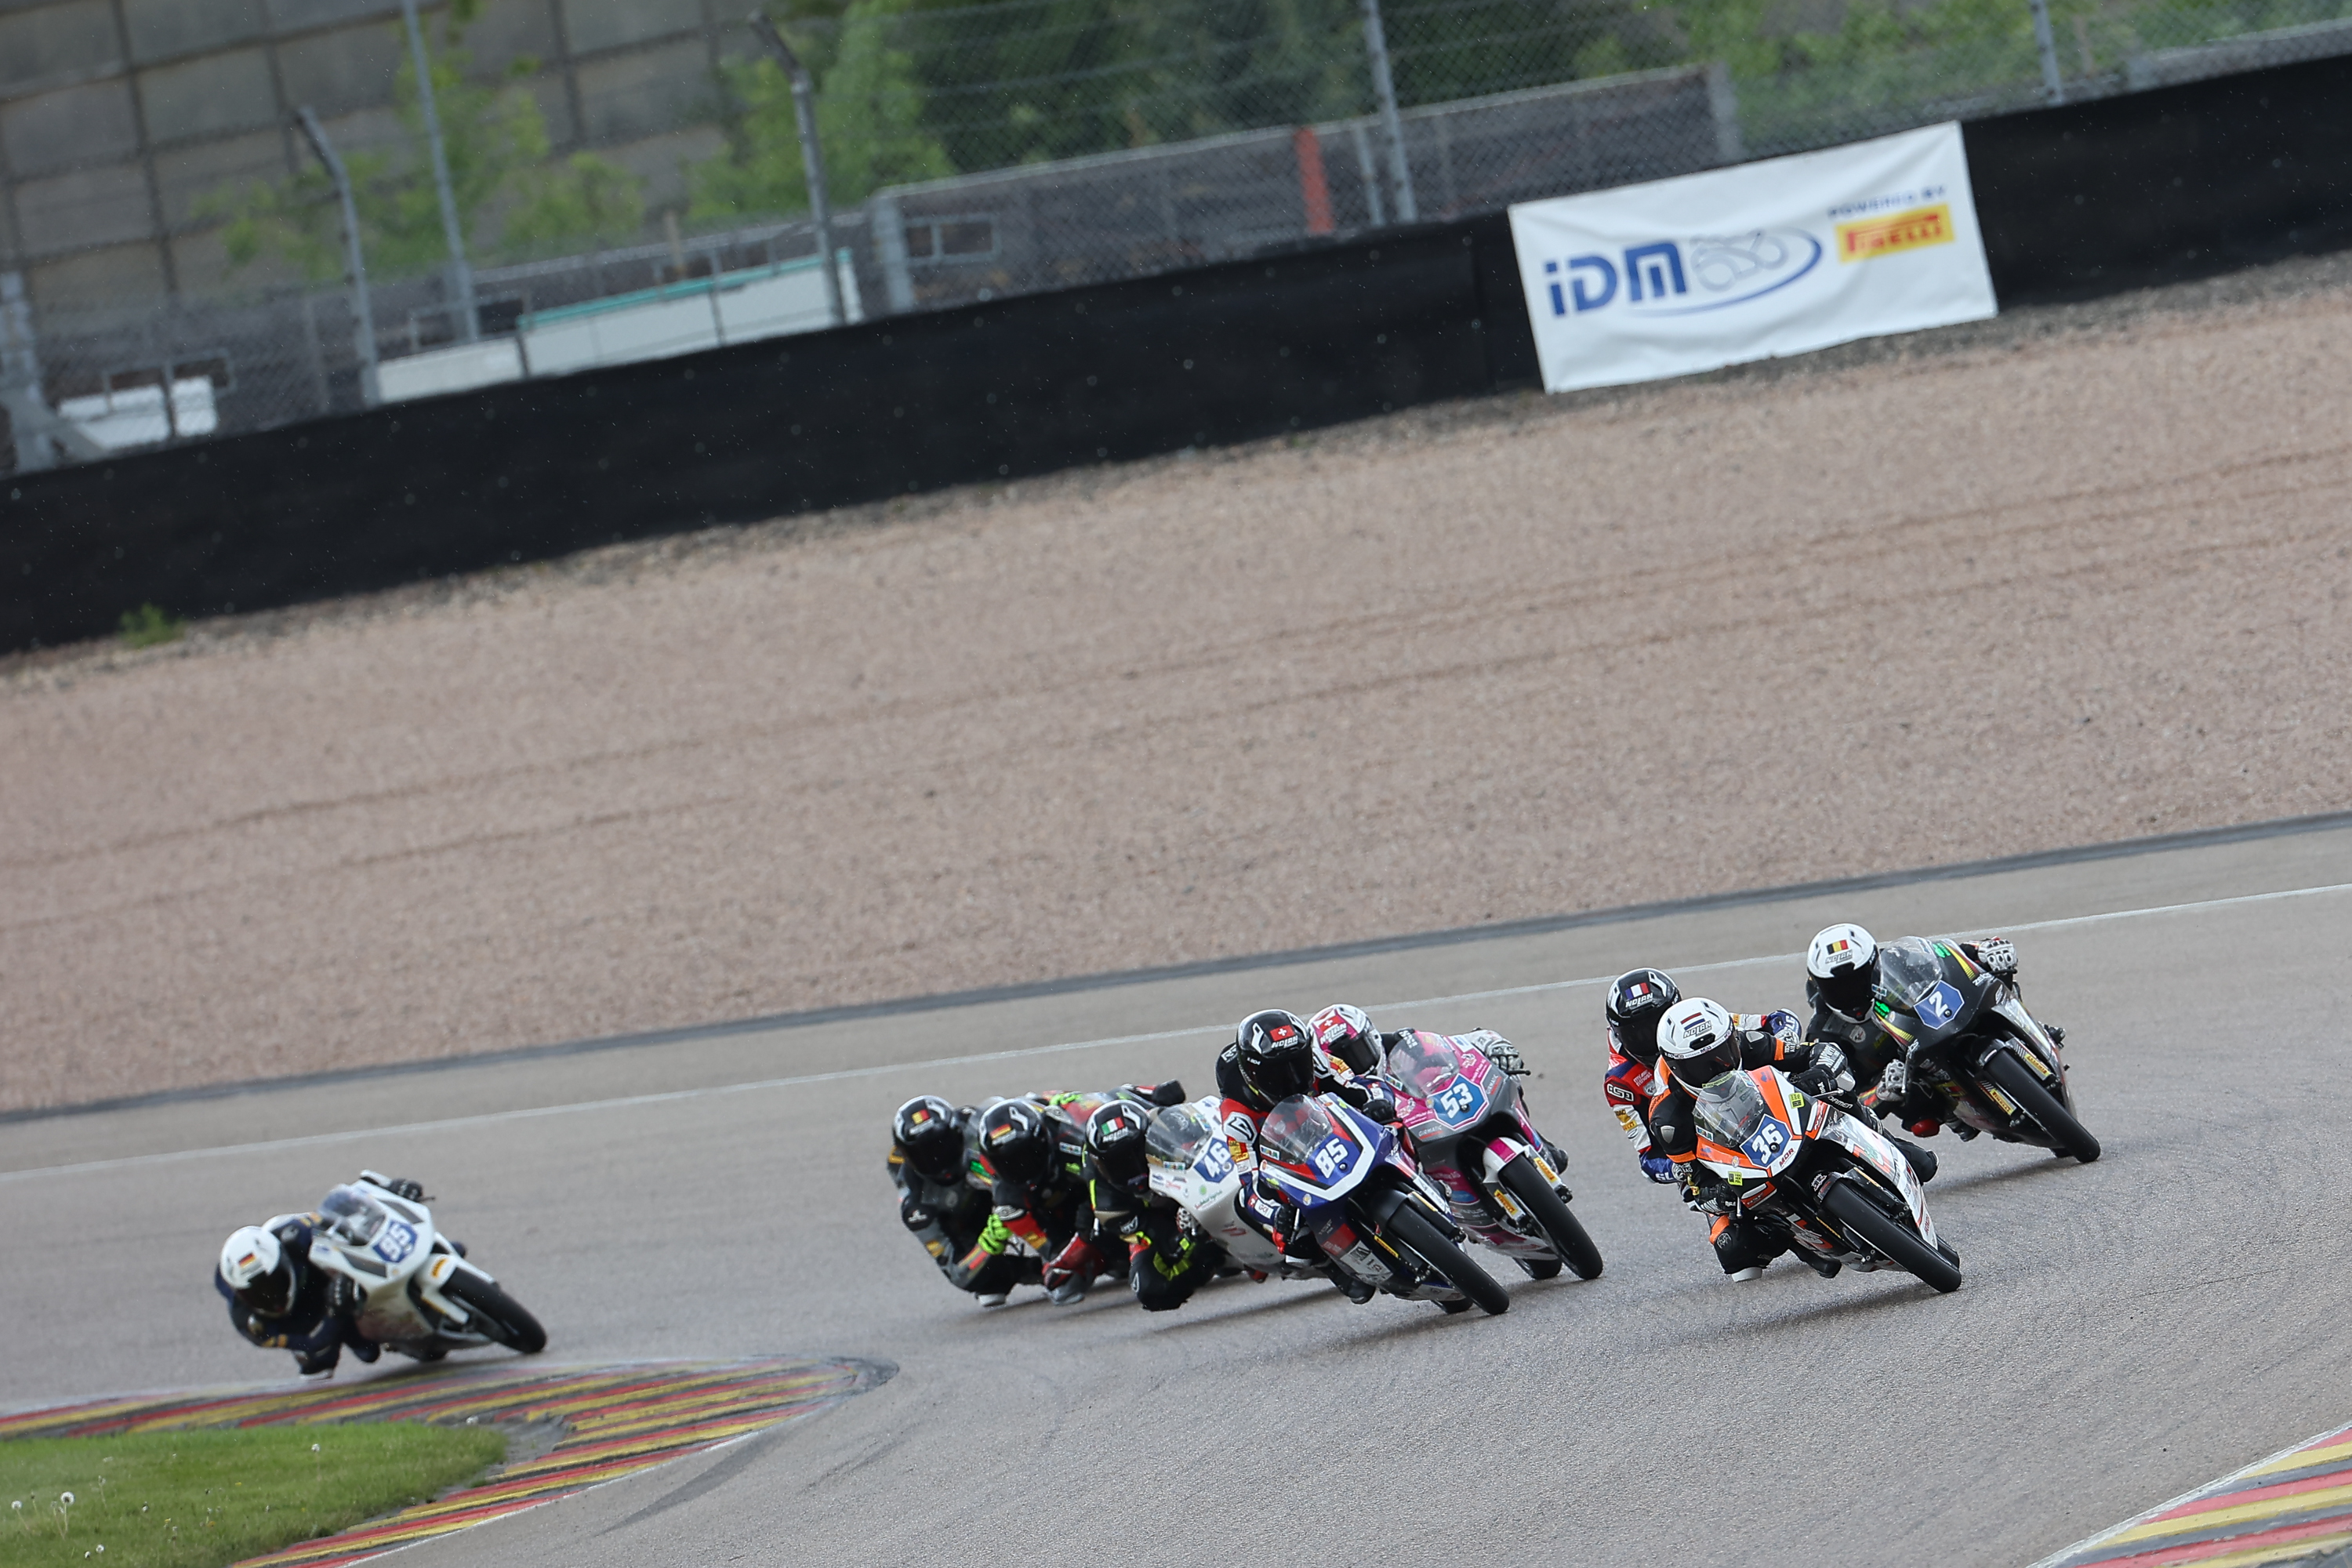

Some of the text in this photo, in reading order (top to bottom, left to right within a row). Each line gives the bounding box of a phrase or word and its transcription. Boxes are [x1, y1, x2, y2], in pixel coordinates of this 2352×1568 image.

[1846, 214, 1942, 252] PIRELLI
[1825, 949, 1853, 964] NOLAN
[1625, 993, 1654, 1008] NOLAN
[1929, 991, 1949, 1018] 2
[1271, 1036, 1298, 1049] NOLAN
[1320, 1022, 1347, 1044] NOLAN
[1683, 1020, 1712, 1039] NOLAN
[1440, 1083, 1474, 1119] 53
[1315, 1138, 1348, 1179] 85
[1751, 1123, 1784, 1164] 36
[1204, 1142, 1231, 1178] 46
[379, 1223, 411, 1261] 95
